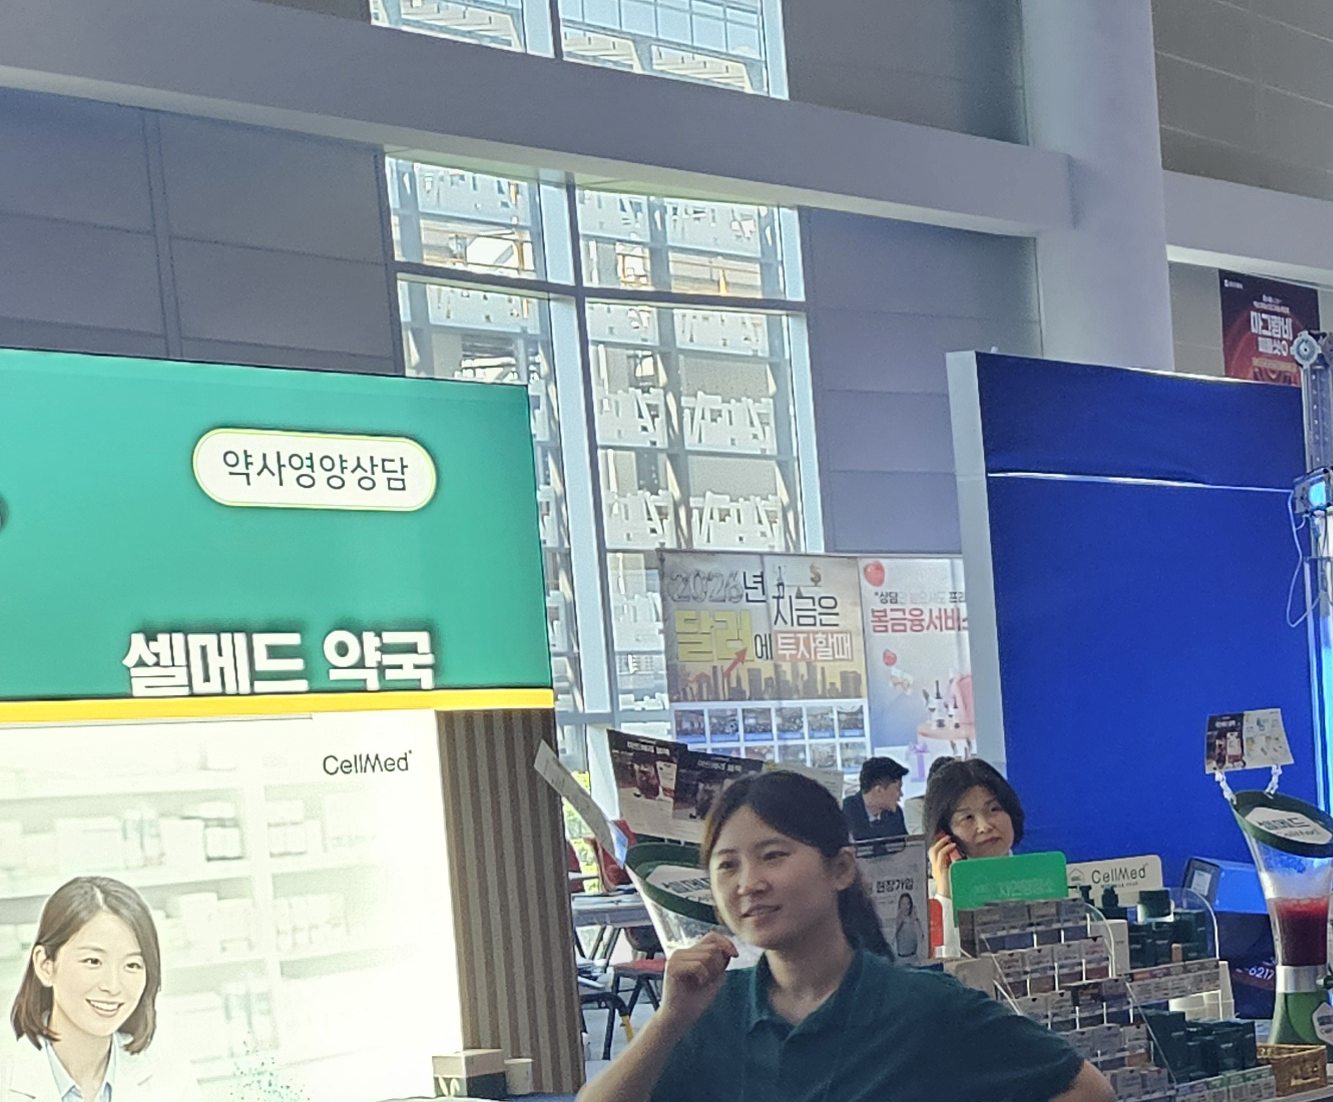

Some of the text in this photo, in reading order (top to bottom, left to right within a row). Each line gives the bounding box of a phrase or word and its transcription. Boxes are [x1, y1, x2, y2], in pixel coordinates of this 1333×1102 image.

[222, 449, 409, 493] 약사영양상담
[773, 594, 840, 627] 지금은
[775, 631, 853, 662] 투자할때
[123, 629, 436, 697] 셀메드 약국
[322, 750, 412, 776] CellMed
[1090, 864, 1148, 884] CellMed
